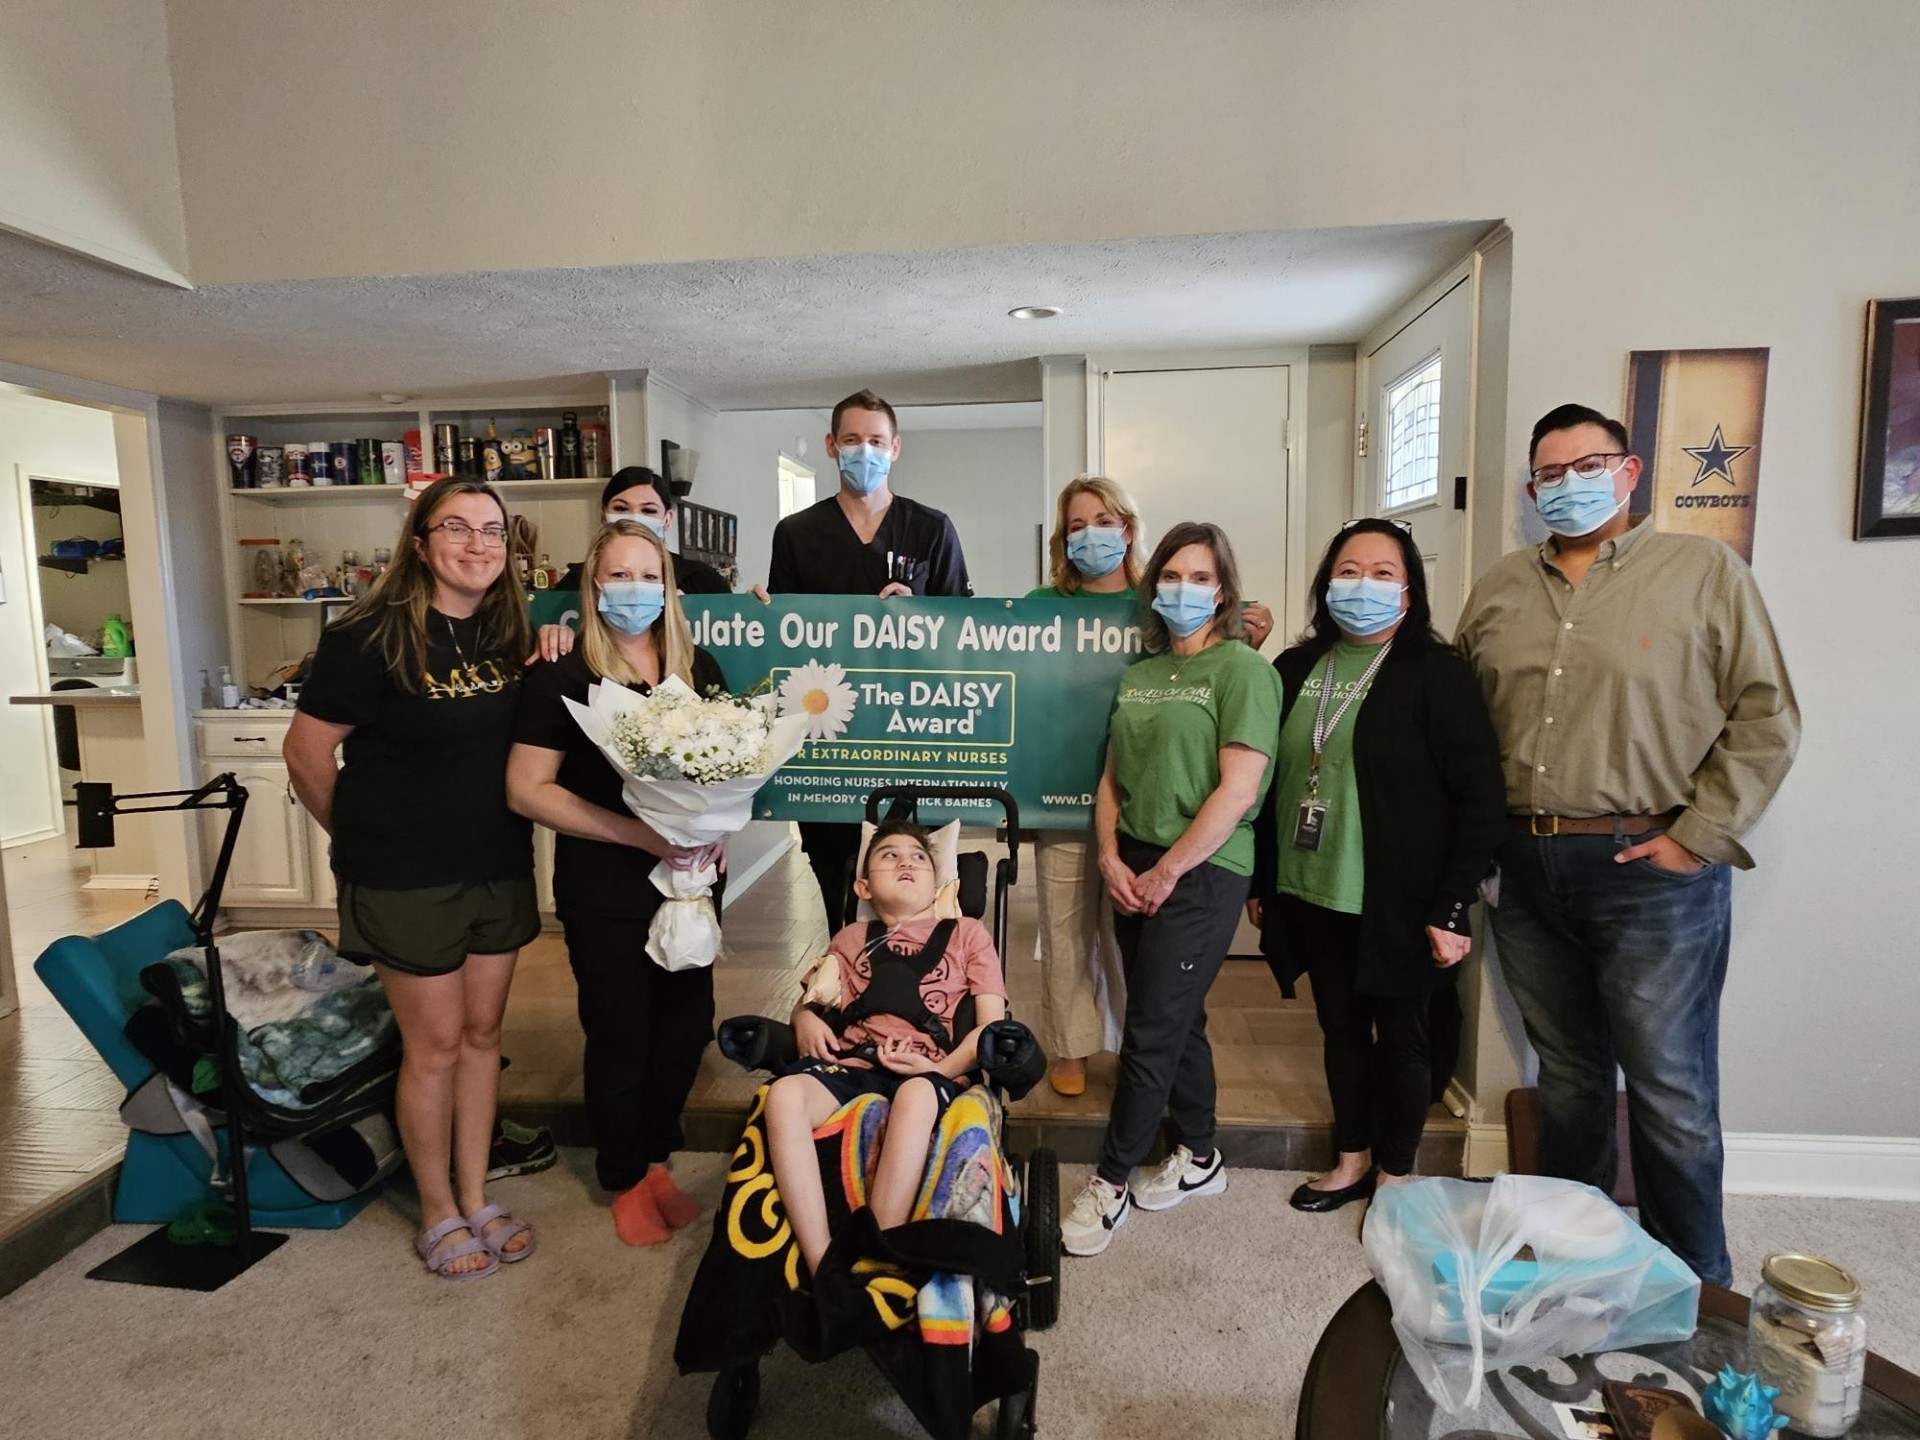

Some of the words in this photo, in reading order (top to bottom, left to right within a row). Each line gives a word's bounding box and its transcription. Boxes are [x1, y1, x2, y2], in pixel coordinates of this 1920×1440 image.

[1675, 494, 1750, 508] COWBOYS
[780, 612, 839, 648] Our
[853, 614, 944, 650] DAISY
[957, 615, 1061, 652] Award
[860, 683, 905, 705] The
[910, 681, 1002, 708] DAISY
[812, 748, 941, 762] EXTRAORDINARY
[947, 751, 1008, 764] NURSES
[774, 775, 841, 786] HONORING
[844, 777, 891, 788] NURSES
[788, 793, 800, 802] IN
[803, 794, 857, 804] MEMORY
[916, 797, 942, 807] RICK
[945, 798, 992, 808] BARNES
